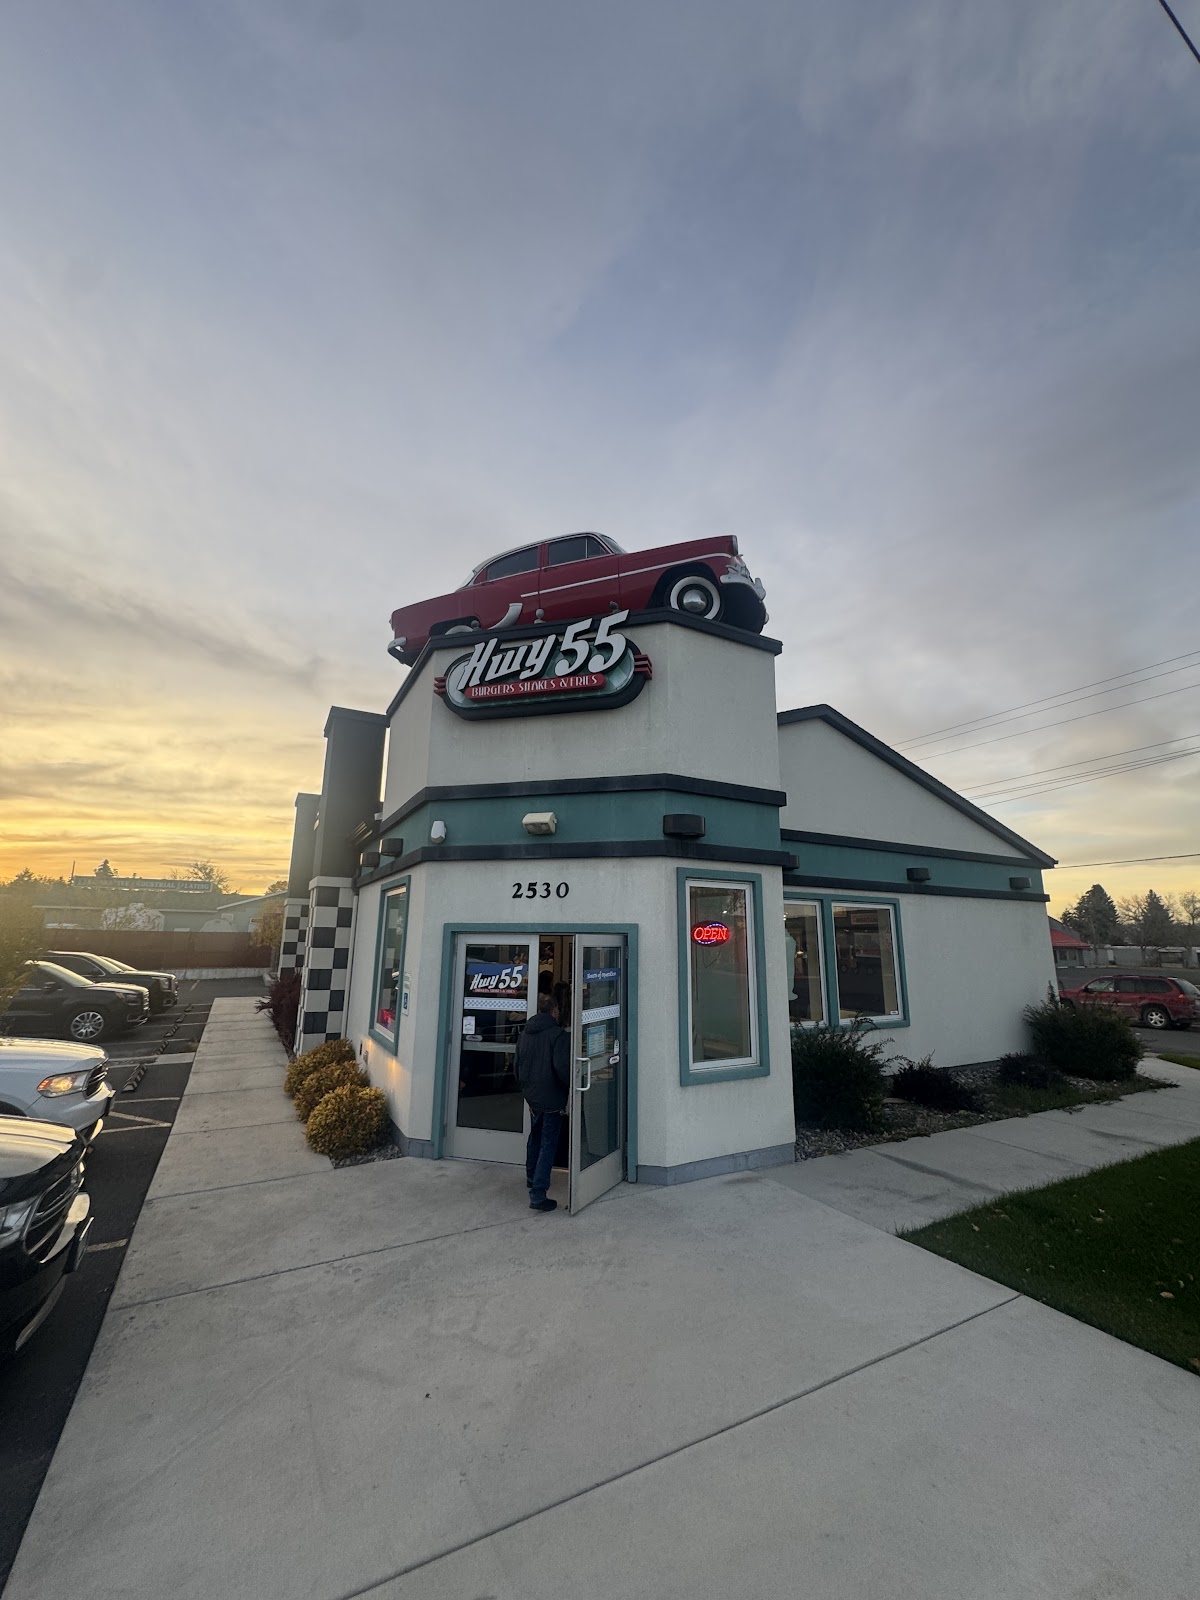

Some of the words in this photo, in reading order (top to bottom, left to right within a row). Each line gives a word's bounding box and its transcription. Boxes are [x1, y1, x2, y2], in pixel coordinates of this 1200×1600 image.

[457, 634, 556, 691] Hwy
[554, 609, 630, 677] 55
[471, 684, 515, 697] BURGERS
[518, 678, 556, 692] SHAKES
[568, 675, 598, 687] FRIES
[512, 882, 569, 899] 2530
[693, 926, 728, 940] OPEN
[470, 973, 499, 990] Hwy
[498, 965, 524, 989] 55
